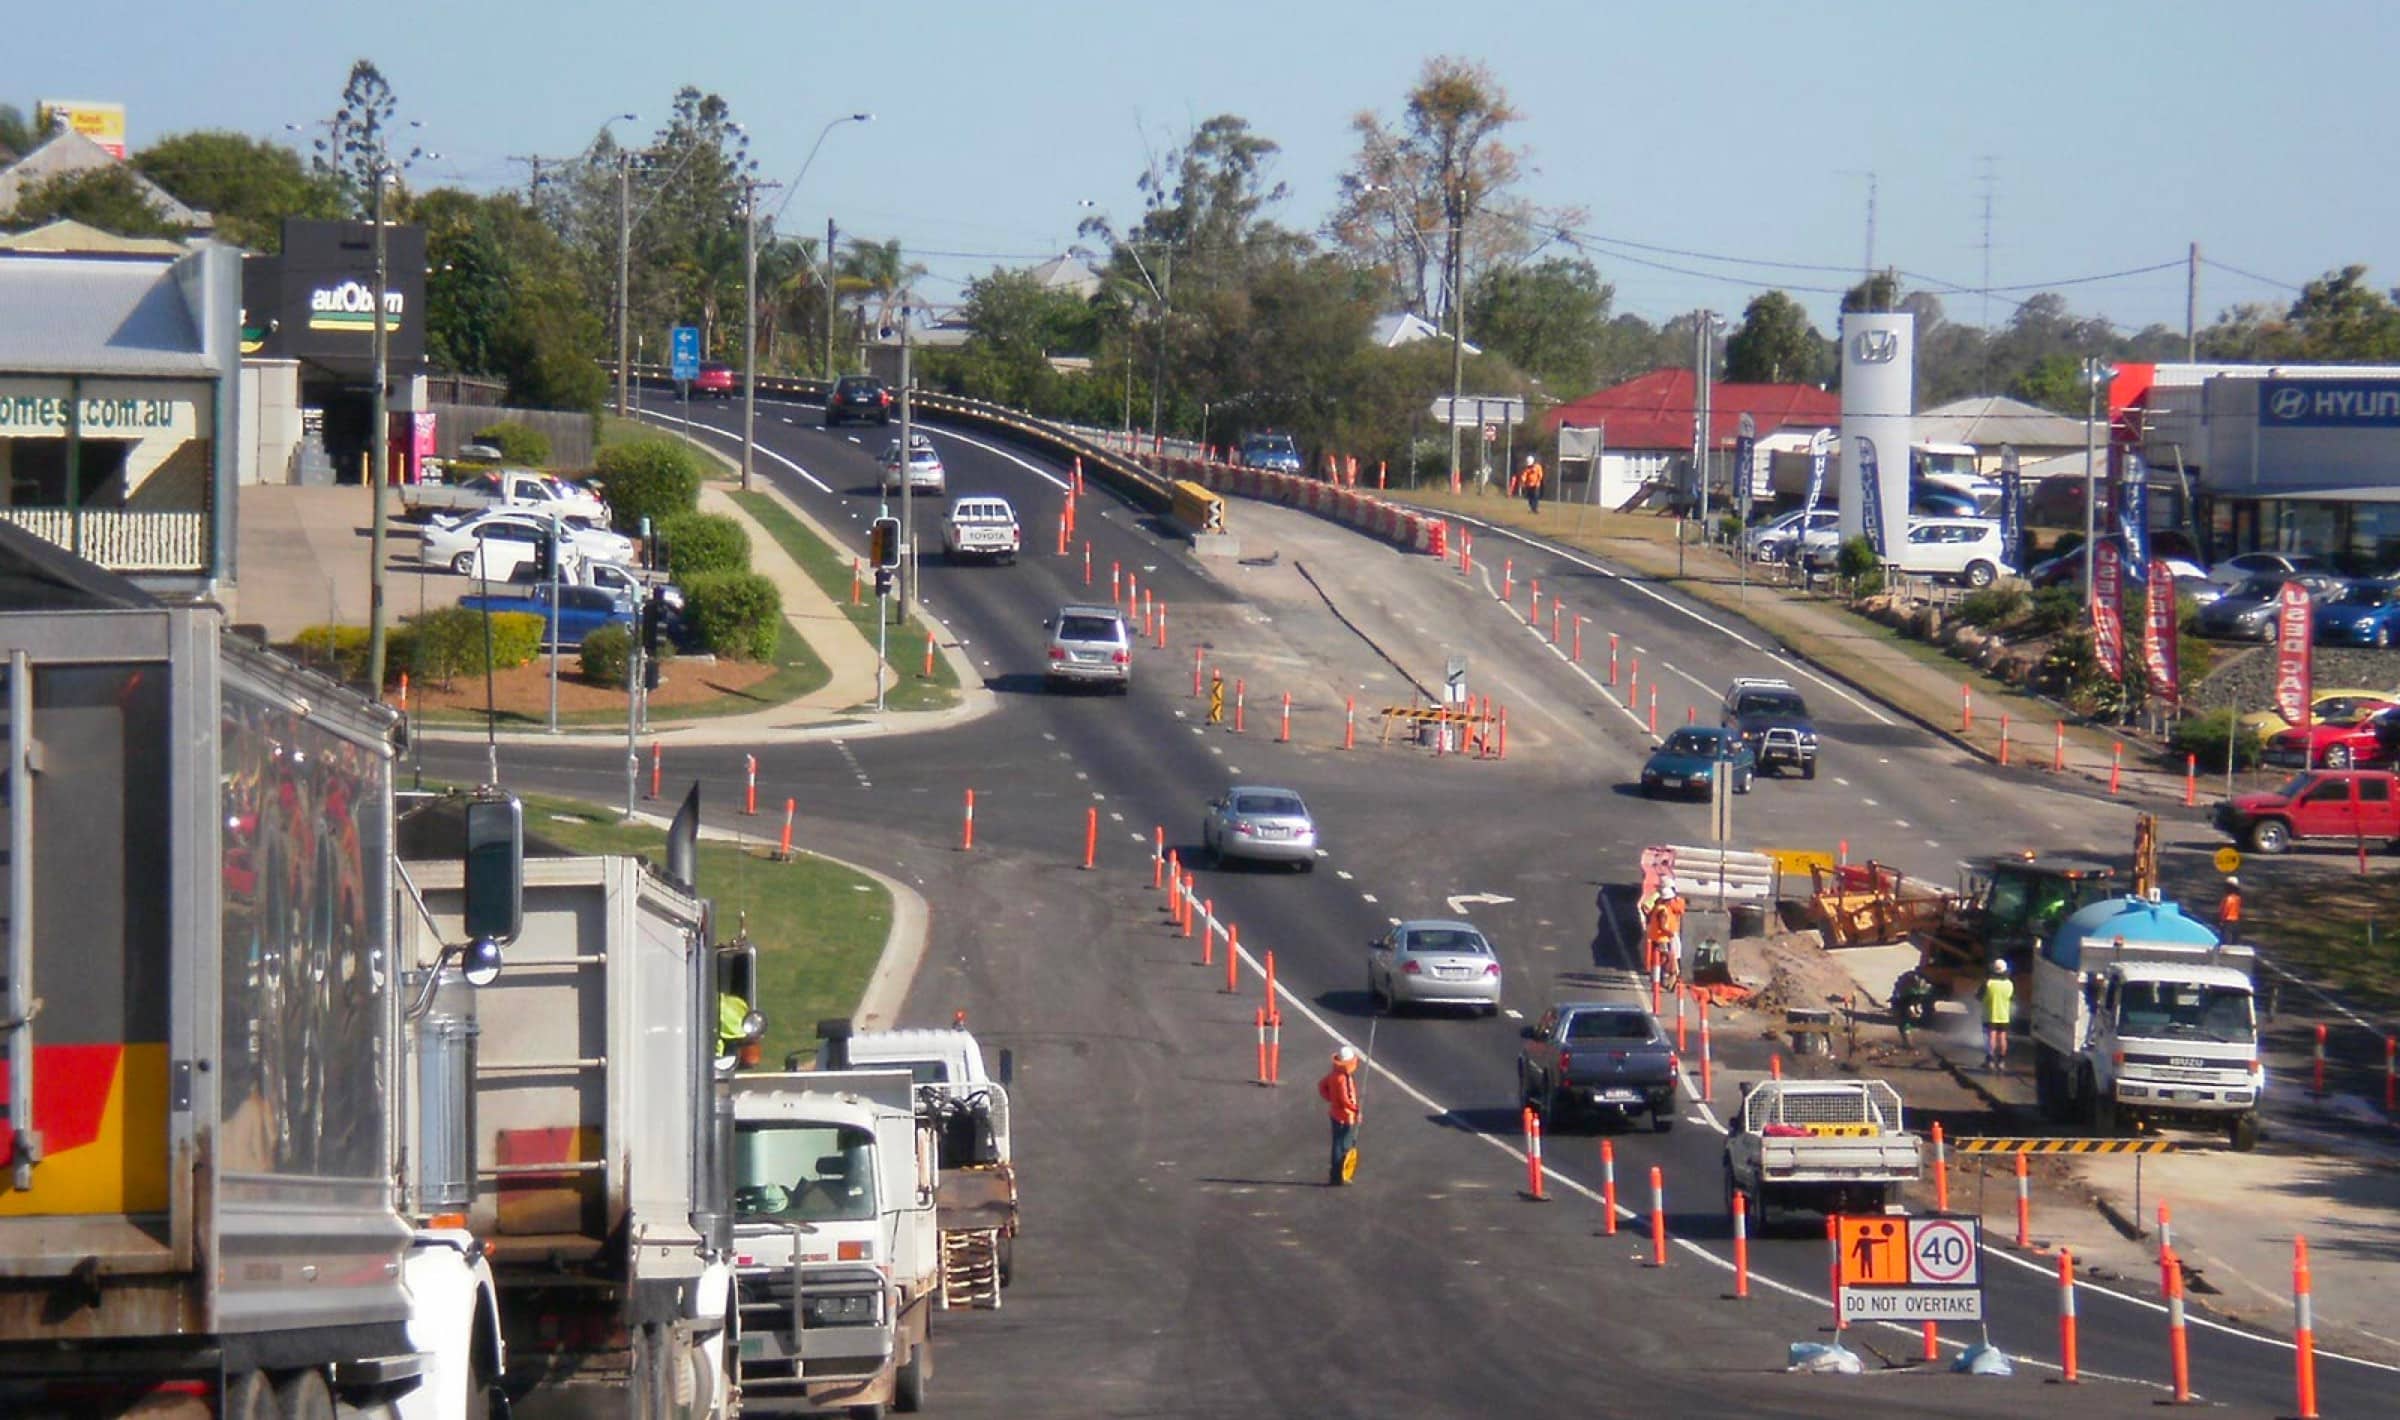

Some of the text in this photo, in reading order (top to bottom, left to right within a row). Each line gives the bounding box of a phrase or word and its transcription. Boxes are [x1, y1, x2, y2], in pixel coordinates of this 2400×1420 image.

[970, 532, 1005, 540] TOYOTA
[2149, 571, 2173, 628] USED
[2279, 591, 2309, 721] USED CARS
[2170, 1058, 2204, 1067] ISUZU
[1922, 1237, 1964, 1266] 40
[1847, 1296, 1974, 1313] DO NOT OVERTAKE
